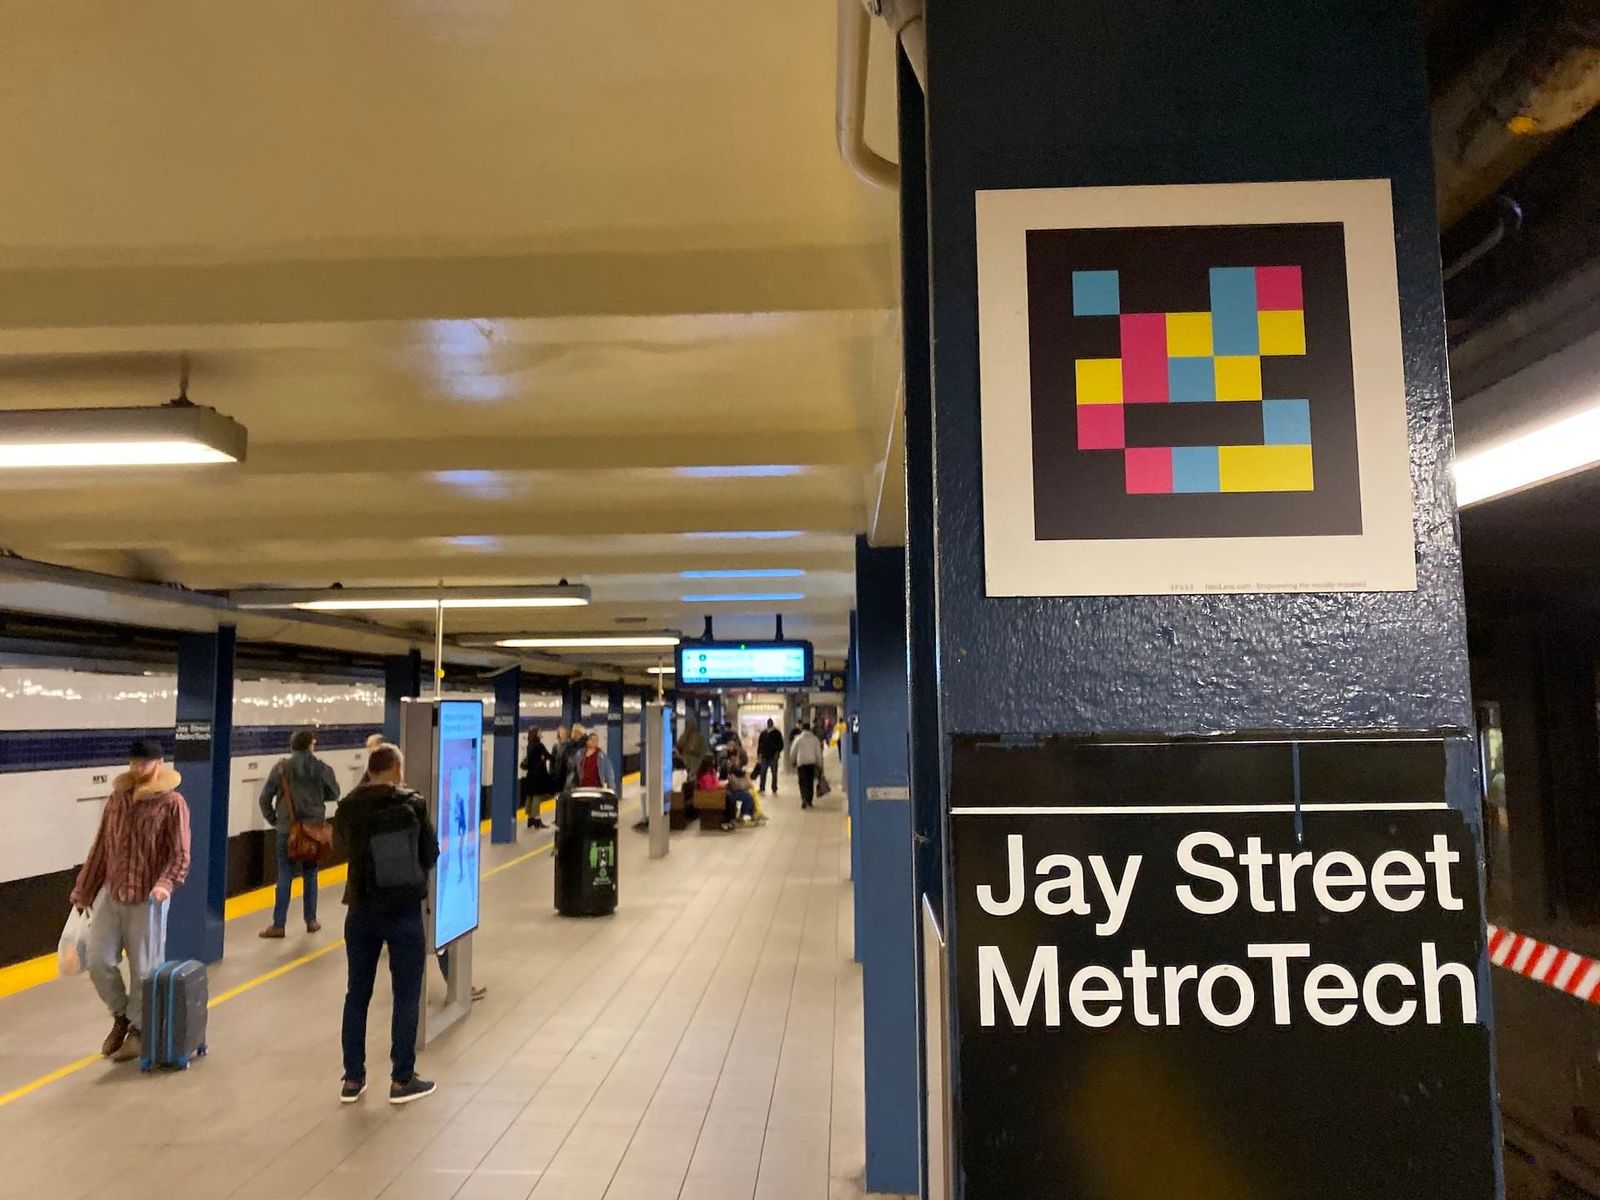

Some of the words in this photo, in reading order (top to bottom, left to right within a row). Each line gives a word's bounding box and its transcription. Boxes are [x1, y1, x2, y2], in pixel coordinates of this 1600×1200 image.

[976, 834, 1143, 936] Jay
[1175, 831, 1464, 915] Street
[977, 942, 1478, 1028] MetroTech
